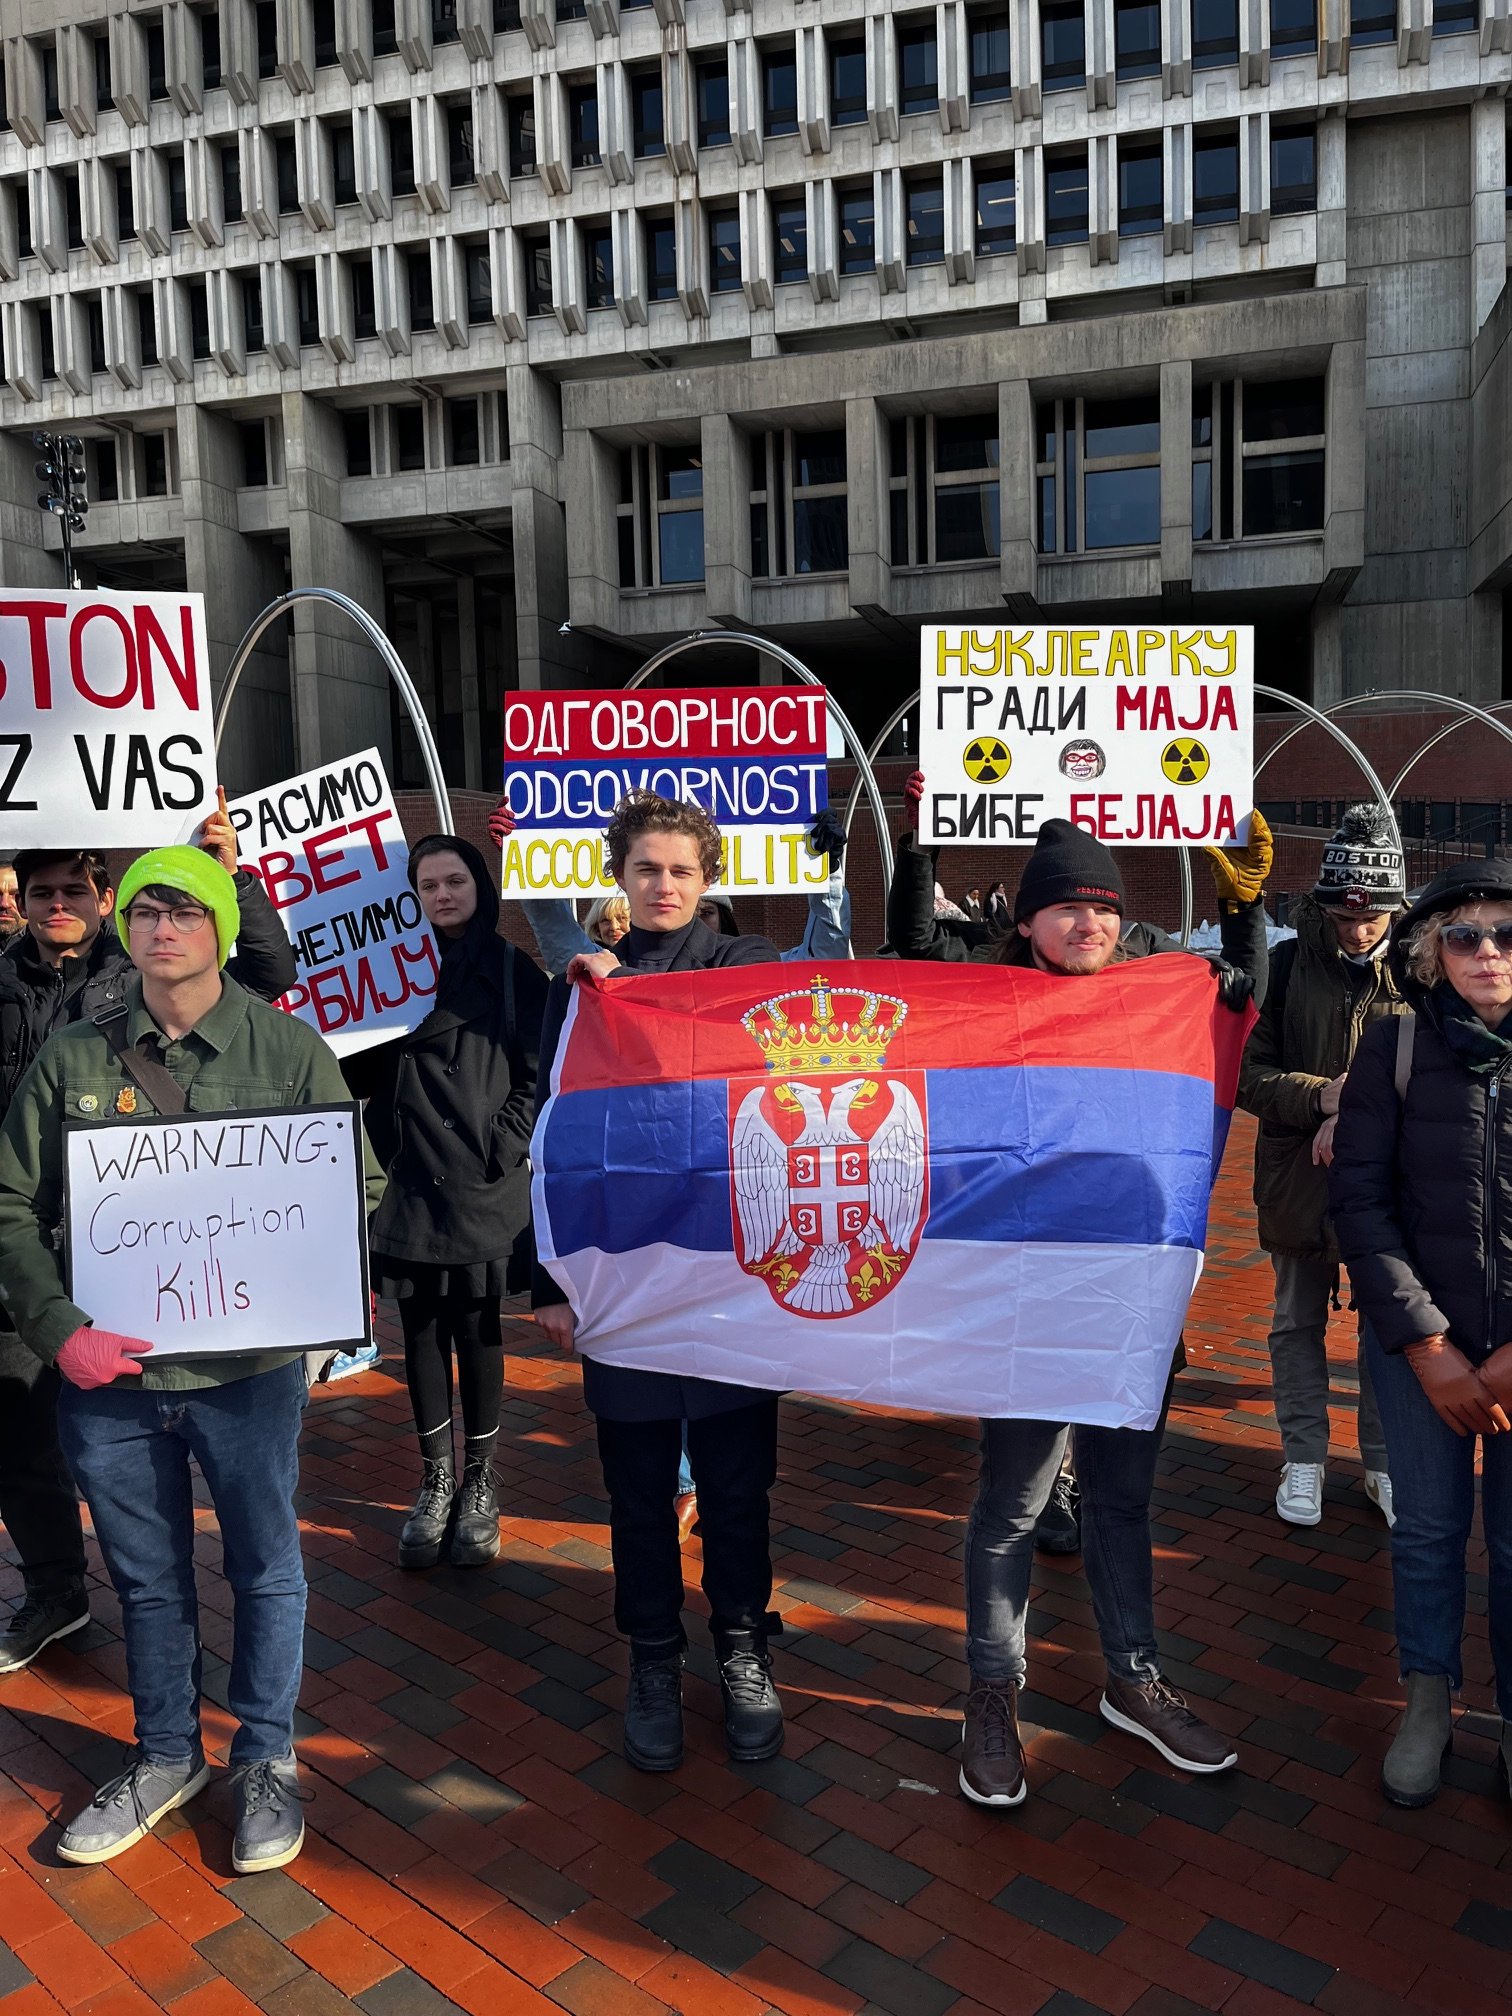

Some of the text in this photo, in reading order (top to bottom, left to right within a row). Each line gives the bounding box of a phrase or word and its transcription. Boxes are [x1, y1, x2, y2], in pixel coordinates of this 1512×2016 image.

[0, 601, 199, 711] TON
[936, 630, 1237, 676] НУКЛЕАРКУ
[505, 695, 825, 755] ОДГОВОРНОСТ
[937, 685, 1238, 735] ГРАДИ МАЈА
[73, 734, 204, 810] VAS
[504, 764, 827, 820] ODGOVORNOST
[932, 793, 1238, 840] БИЋЕ БЕЛАЈА
[503, 833, 829, 890] ACCOUILITY
[1325, 850, 1400, 867] BOSTON
[272, 934, 440, 1034] РБИЈУ
[88, 1120, 345, 1183] WARNING:
[89, 1192, 306, 1276] Corruption
[155, 1257, 251, 1323] Kills
